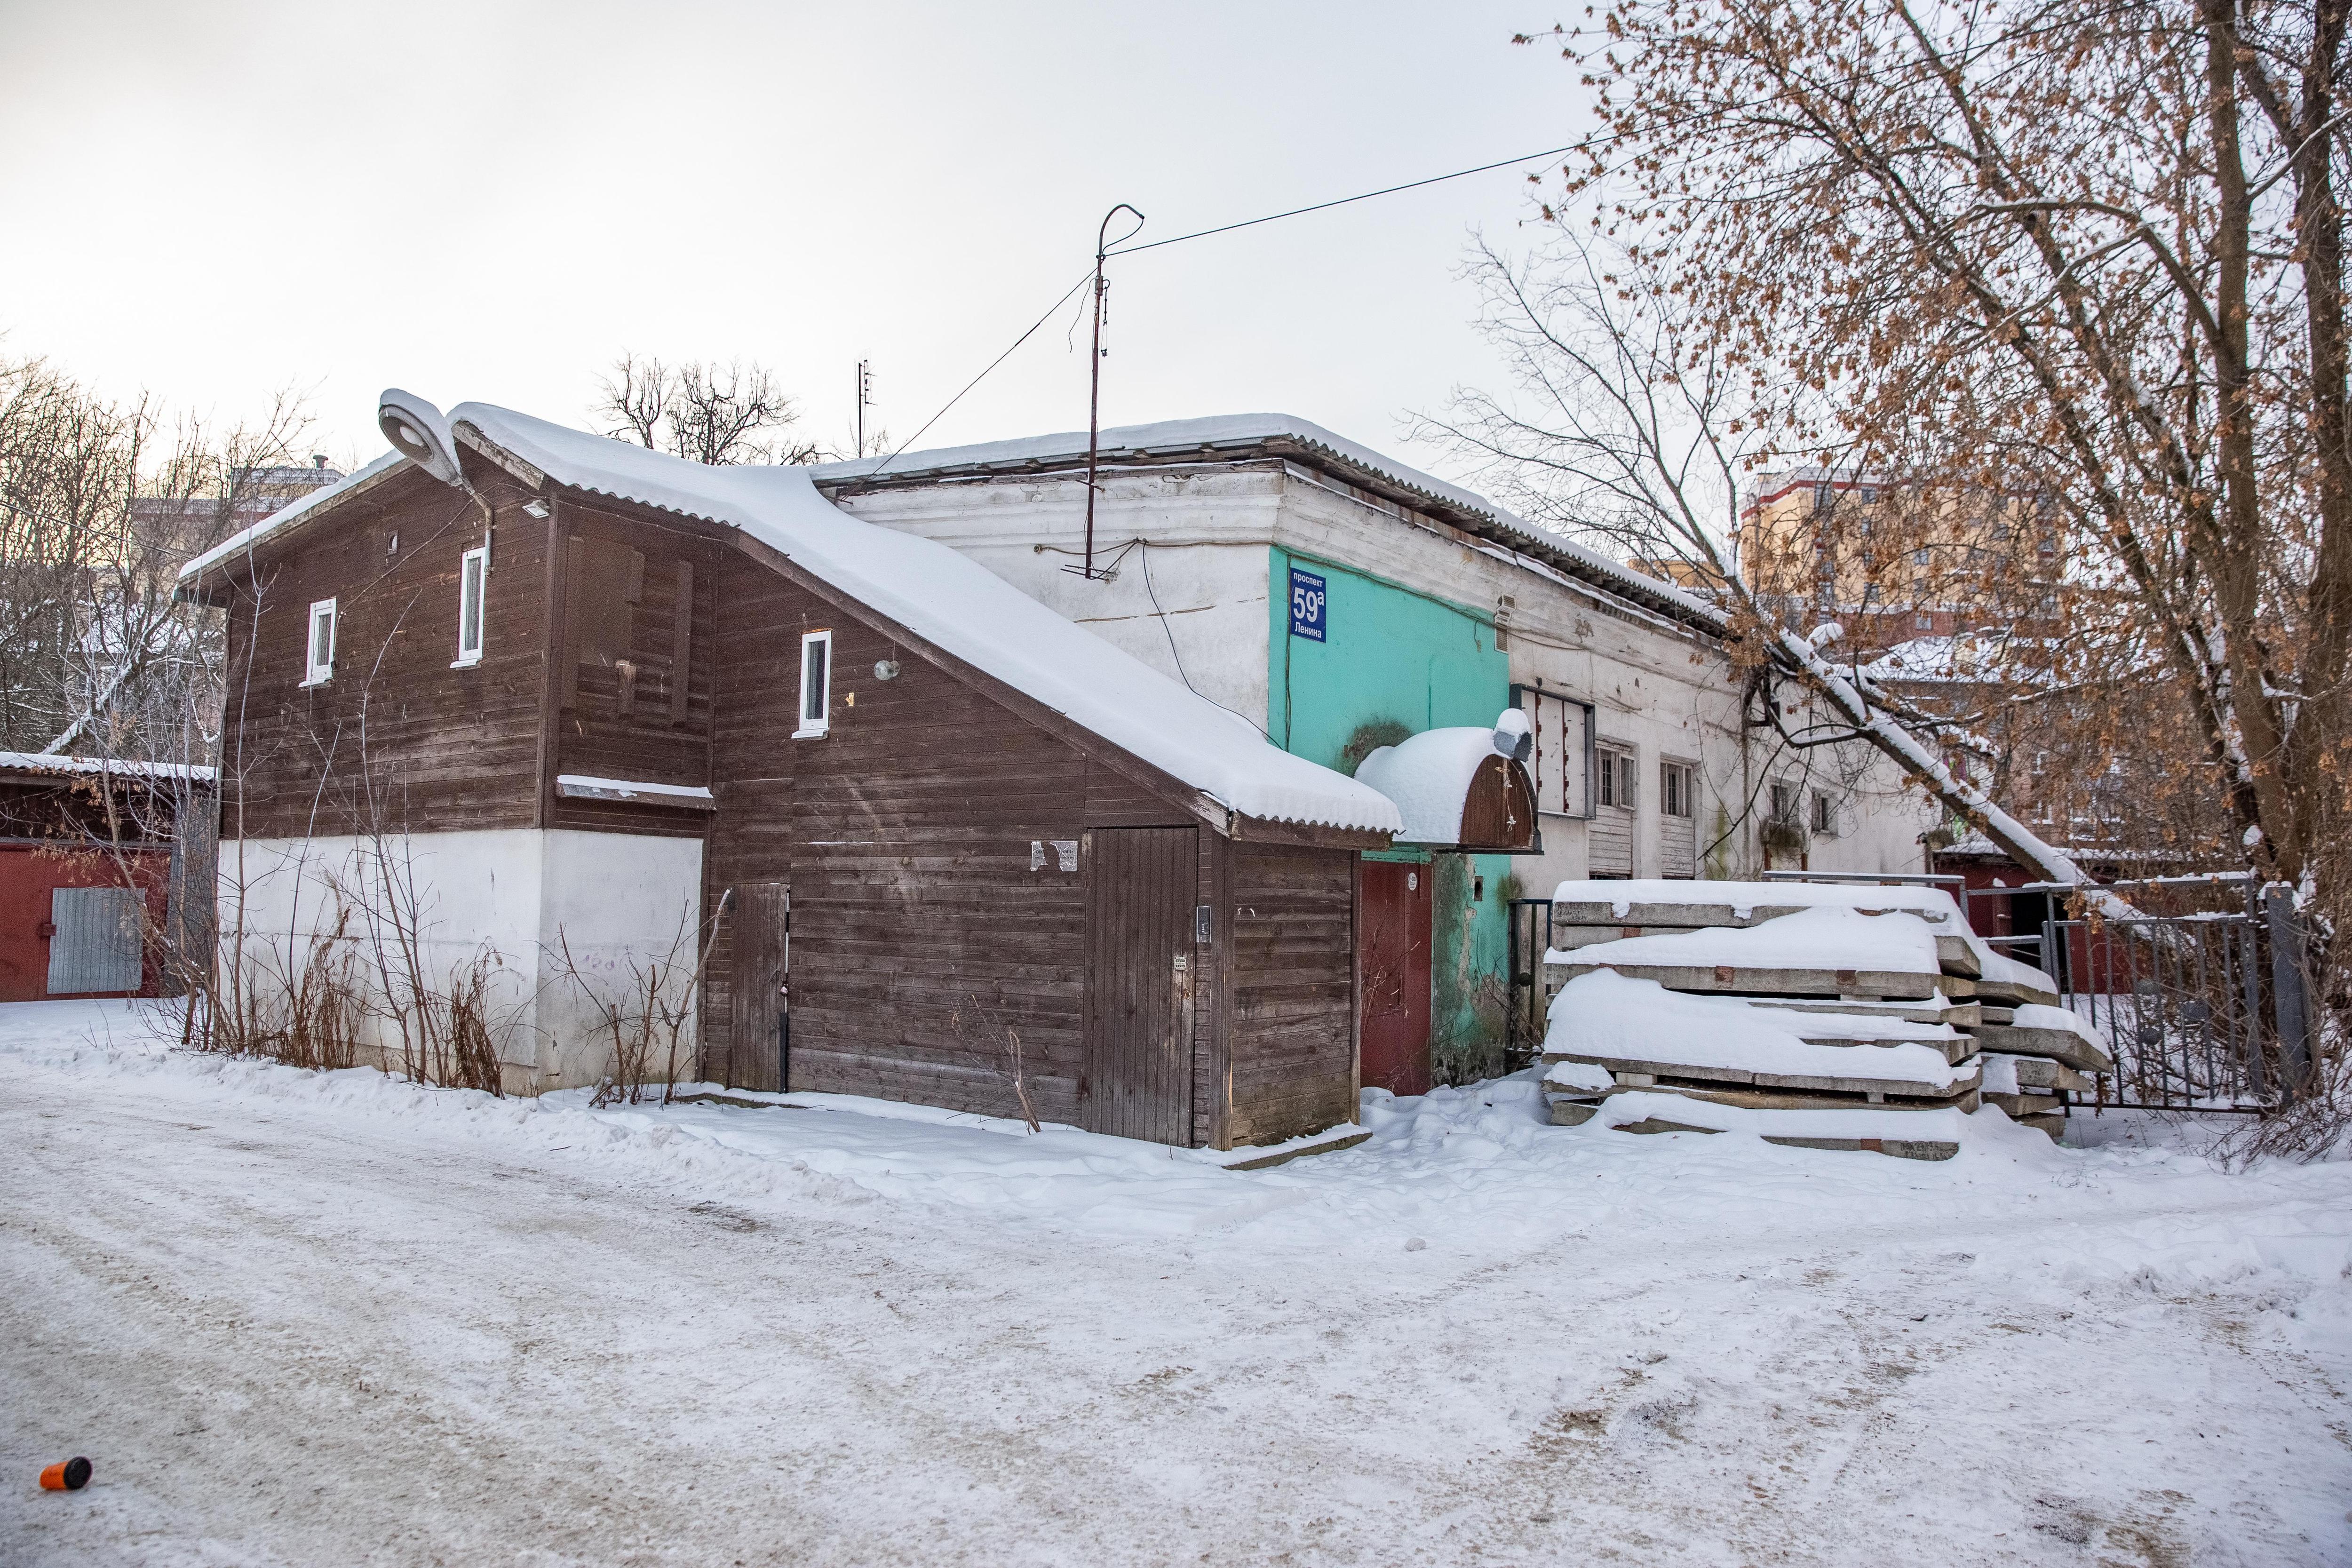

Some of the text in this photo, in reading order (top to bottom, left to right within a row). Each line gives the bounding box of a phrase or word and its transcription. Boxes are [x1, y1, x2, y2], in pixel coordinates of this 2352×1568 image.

[1294, 572, 1323, 588] проспект
[1293, 587, 1324, 622] 59а
[1295, 621, 1322, 638] Ленина
